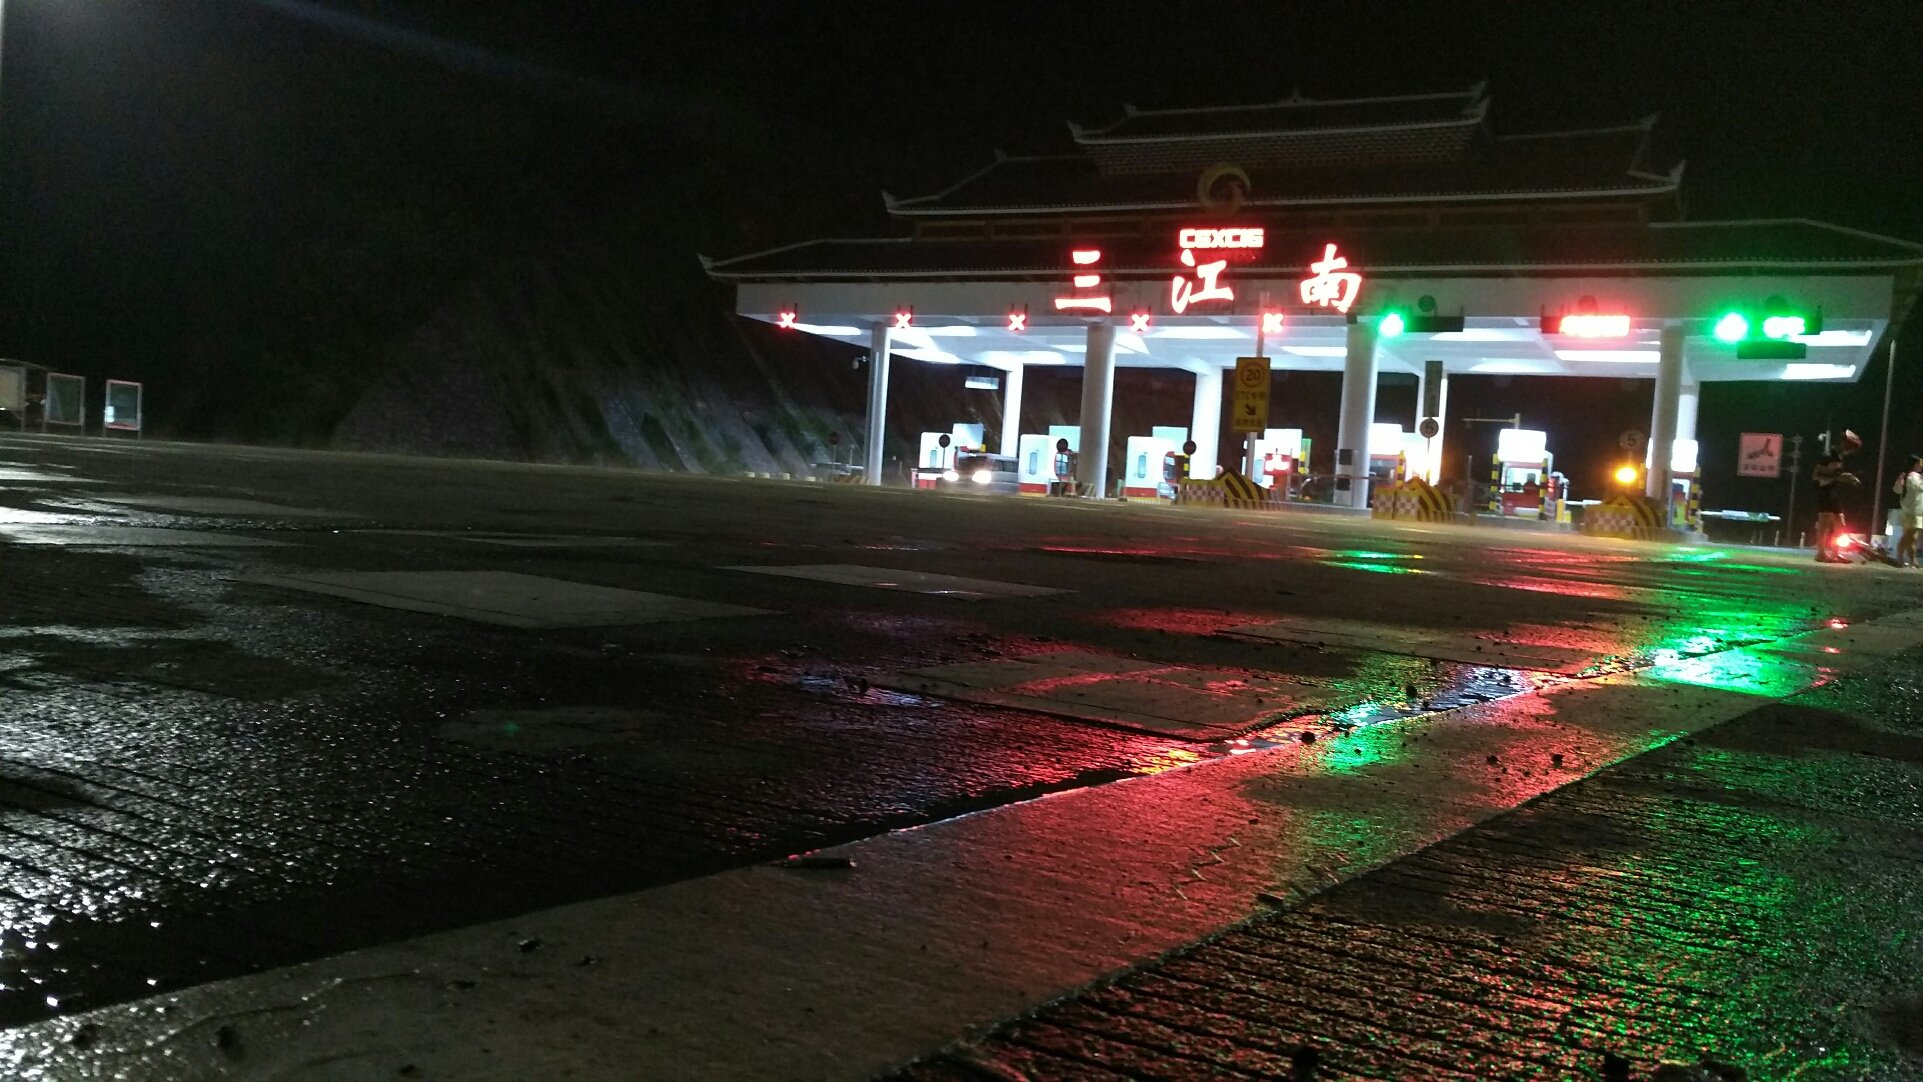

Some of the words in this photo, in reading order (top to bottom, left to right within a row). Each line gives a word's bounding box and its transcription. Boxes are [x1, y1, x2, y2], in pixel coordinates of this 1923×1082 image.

[1055, 244, 1362, 313] 三江南
[1246, 369, 1261, 381] 20
